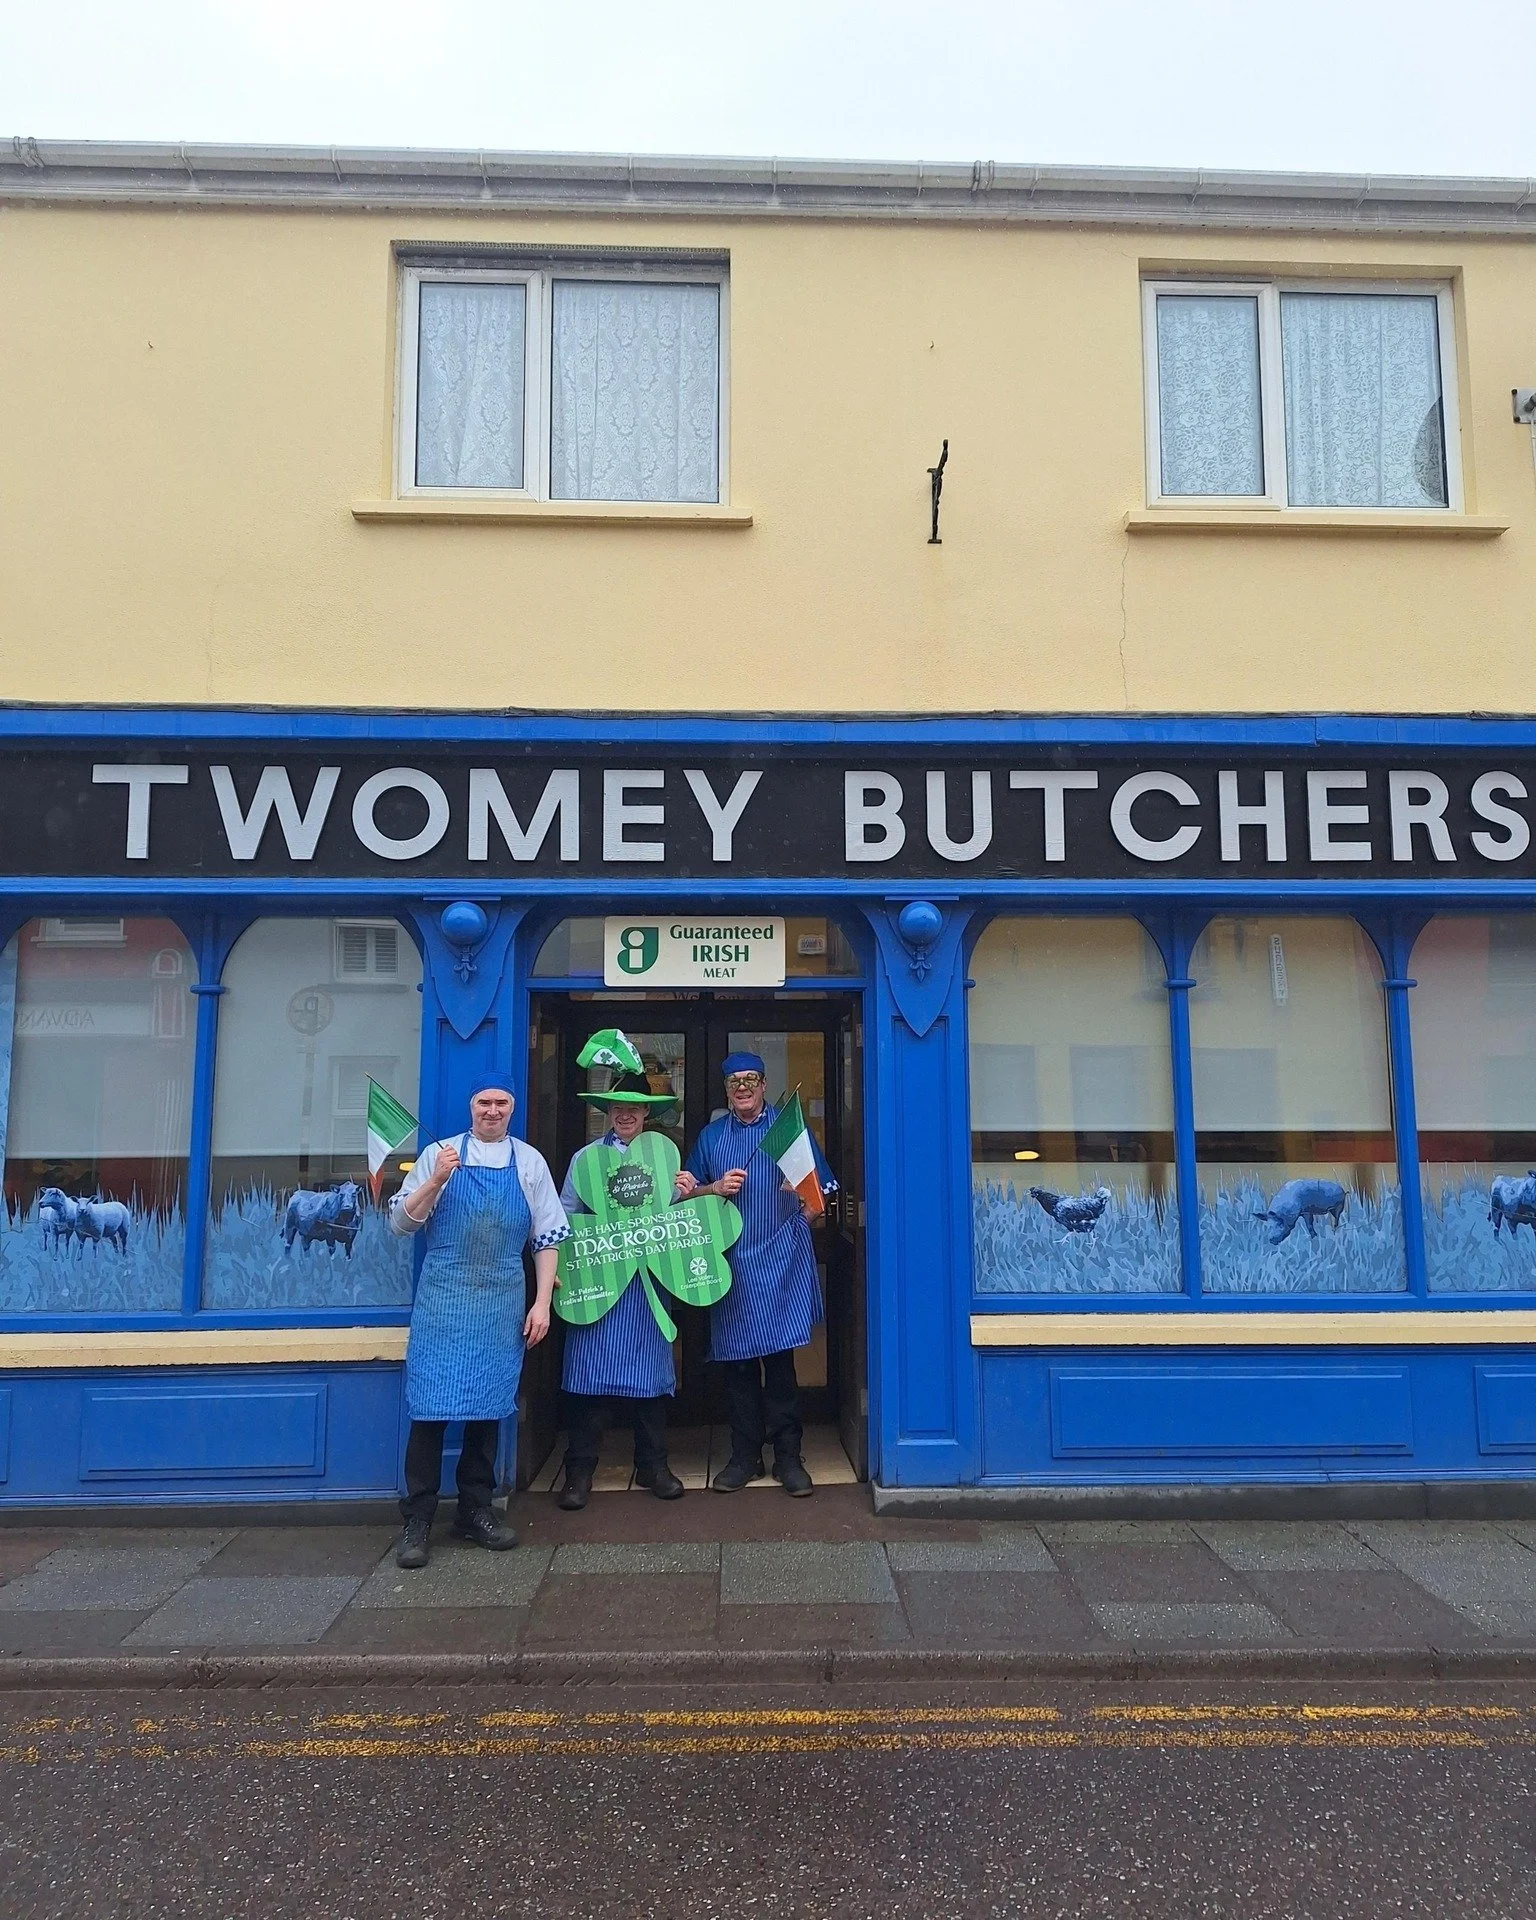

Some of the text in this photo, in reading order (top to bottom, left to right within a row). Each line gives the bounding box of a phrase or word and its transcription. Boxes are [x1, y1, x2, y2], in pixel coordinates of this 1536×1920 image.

[92, 764, 1531, 862] TWOMEY BUTCHERS
[670, 924, 774, 940] Guaranteed
[692, 944, 749, 962] IRISH
[703, 968, 736, 978] MEAT
[616, 1174, 642, 1184] HAPPY
[612, 1185, 620, 1194] St
[624, 1190, 638, 1198] DAY
[575, 1208, 696, 1239] WE HAVE SPONSORED
[572, 1218, 702, 1258] MACROOMS
[566, 1234, 712, 1271] ST. PATRICK'S DAY PARADE
[578, 1285, 603, 1295] Patrick's
